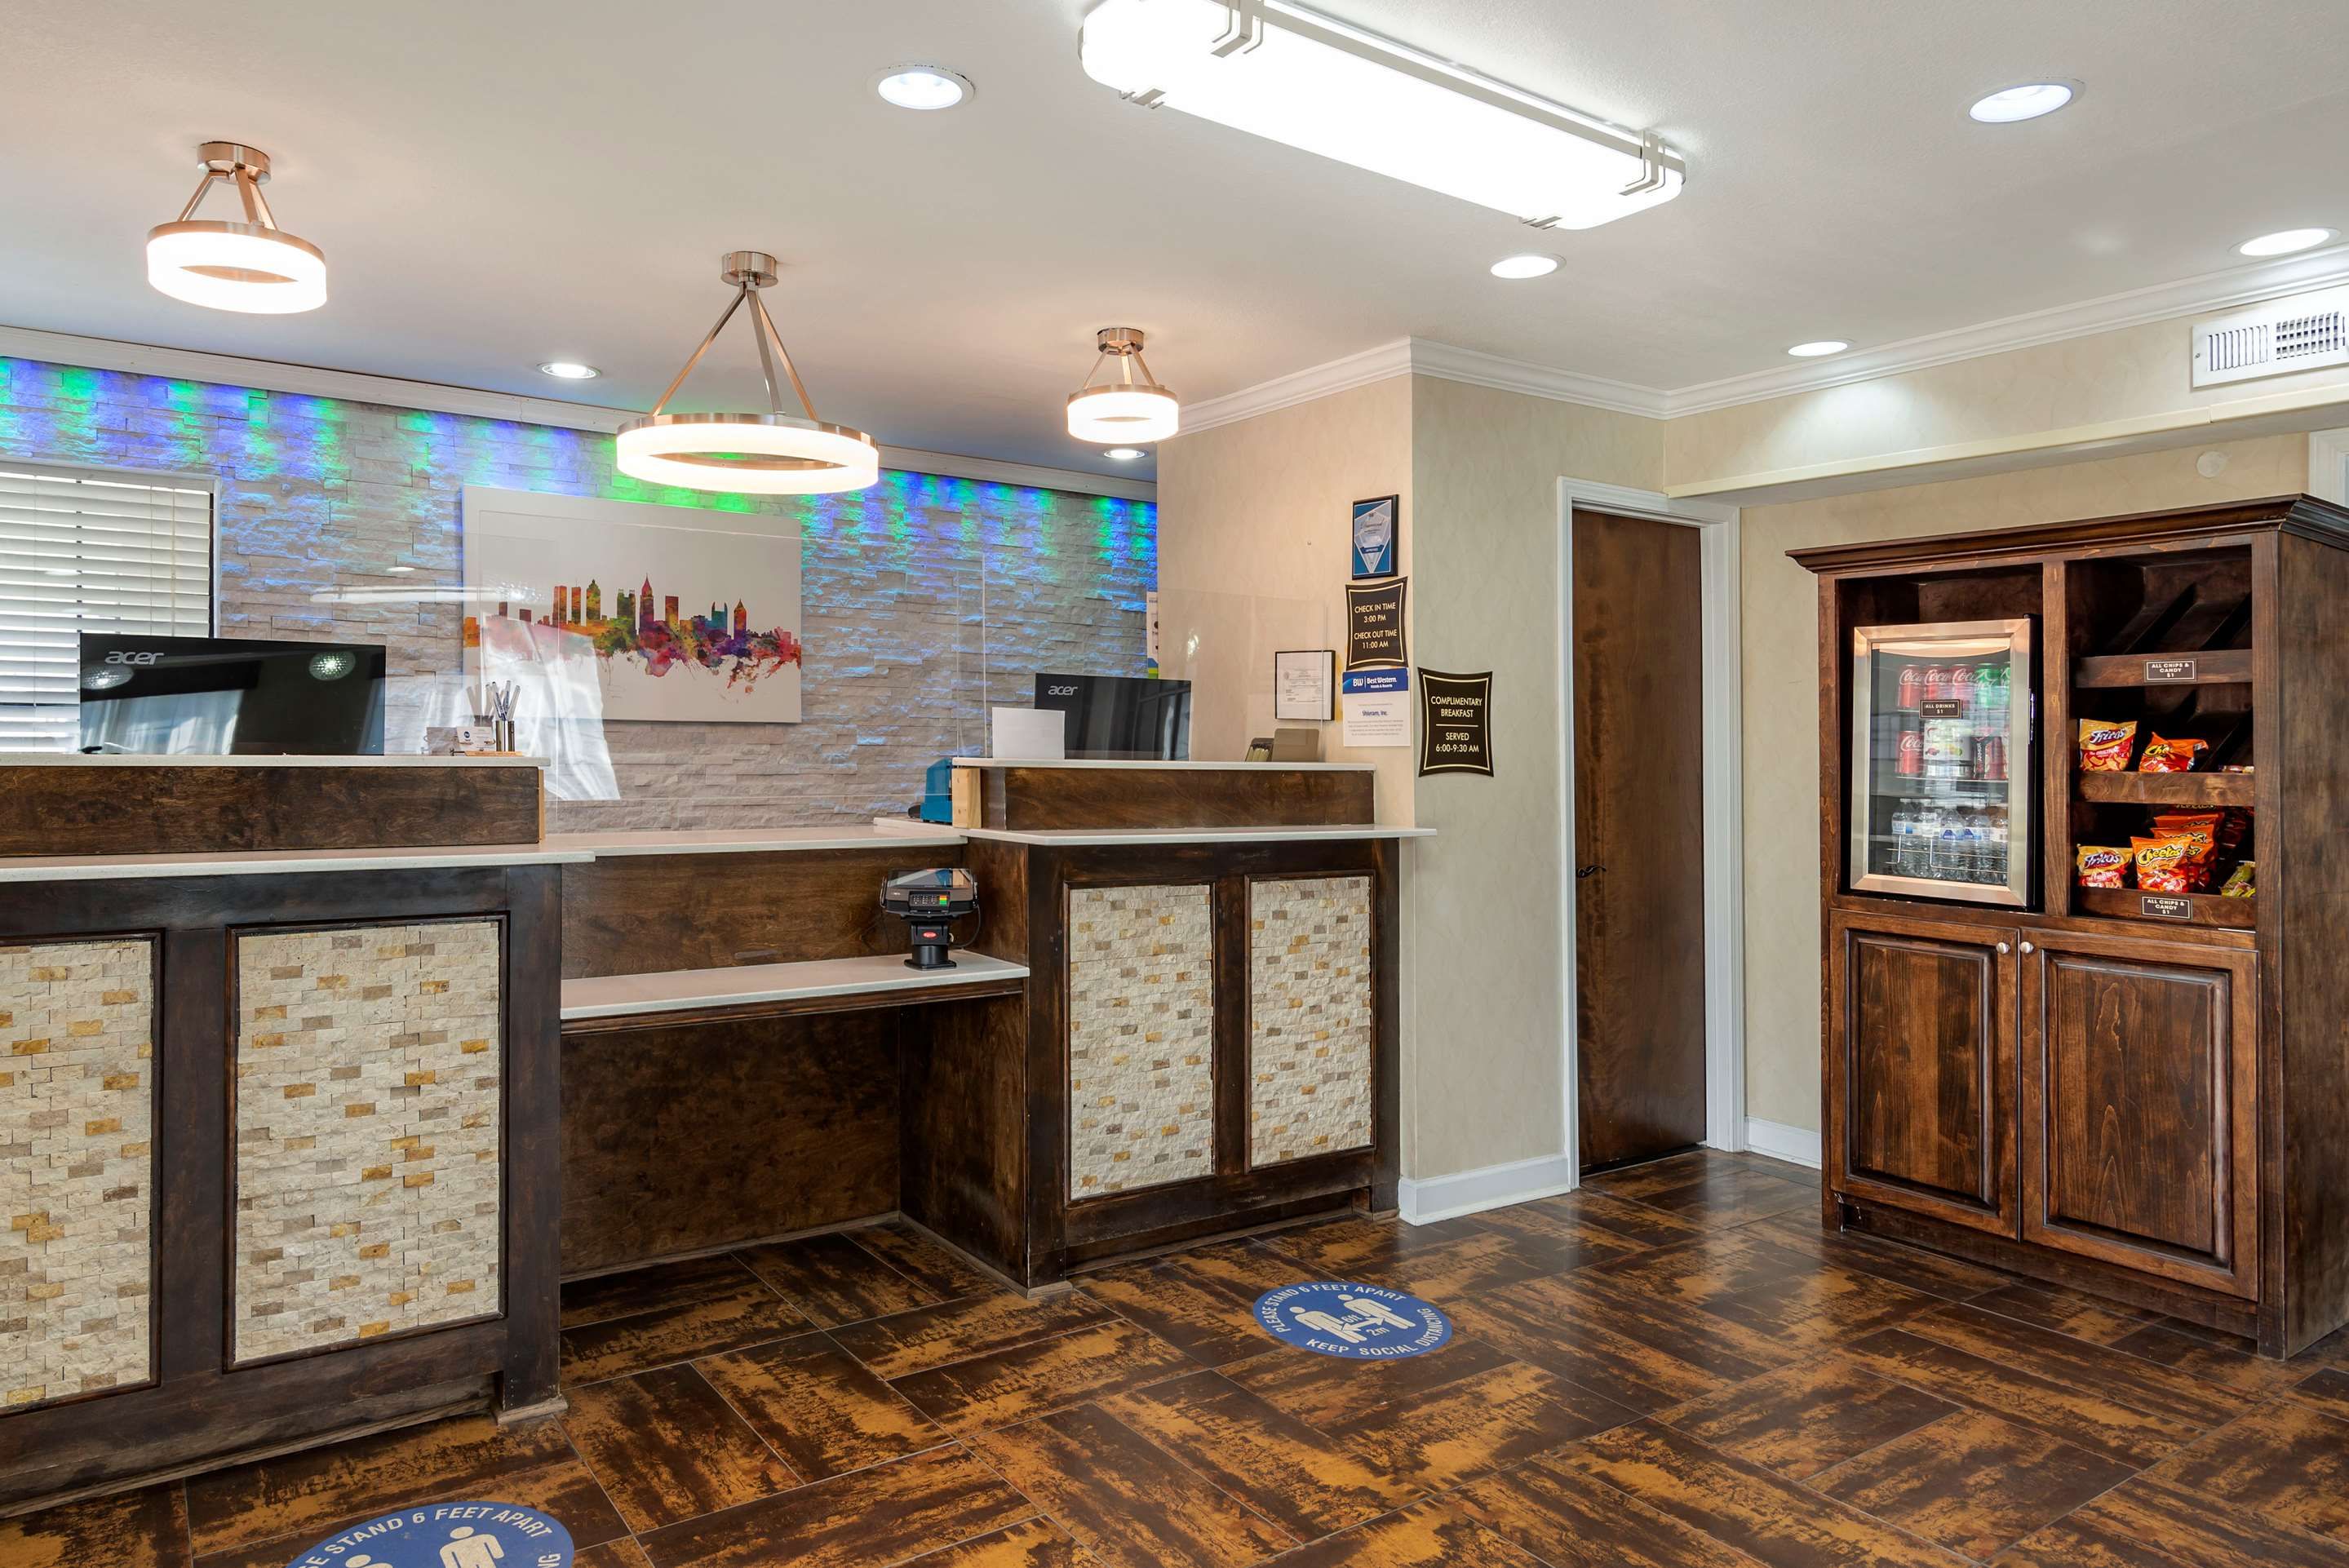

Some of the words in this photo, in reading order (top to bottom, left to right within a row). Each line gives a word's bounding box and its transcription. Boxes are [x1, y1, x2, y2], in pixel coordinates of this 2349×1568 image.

[1354, 604, 1373, 613] CHECK
[1383, 602, 1396, 610] TIME
[1363, 615, 1376, 623] 3:00
[1354, 631, 1372, 640] CHECK
[1372, 630, 1384, 638] OUT
[1385, 629, 1398, 637] TIME
[1363, 641, 1378, 649] 11:00
[1379, 640, 1389, 649] AM
[104, 651, 164, 666] acer
[1353, 678, 1364, 687] BW
[1048, 684, 1079, 696] acer
[1430, 696, 1483, 706] COMPLIMENTARY
[1441, 708, 1474, 718] BREAKFAST
[1445, 732, 1469, 741] SERVED
[2090, 728, 2126, 744] Fritos
[1435, 743, 1468, 752] 6:00-9:30
[1469, 744, 1479, 752] AM
[2085, 853, 2121, 869] Fritos
[2137, 845, 2183, 866] Cheetos
[1265, 1289, 1300, 1307] STAND
[1354, 1286, 1407, 1300] APART
[1261, 1306, 1292, 1332] PLEASE
[1305, 1339, 1350, 1353] KEEP
[1358, 1344, 1419, 1356] SOCIAL
[1414, 1308, 1443, 1347] DISTANCING
[1365, 1327, 1390, 1336] 2m
[324, 1517, 404, 1554] STAND
[412, 1512, 425, 1524] 6
[435, 1507, 494, 1521] FEET
[491, 1509, 553, 1538] APART
